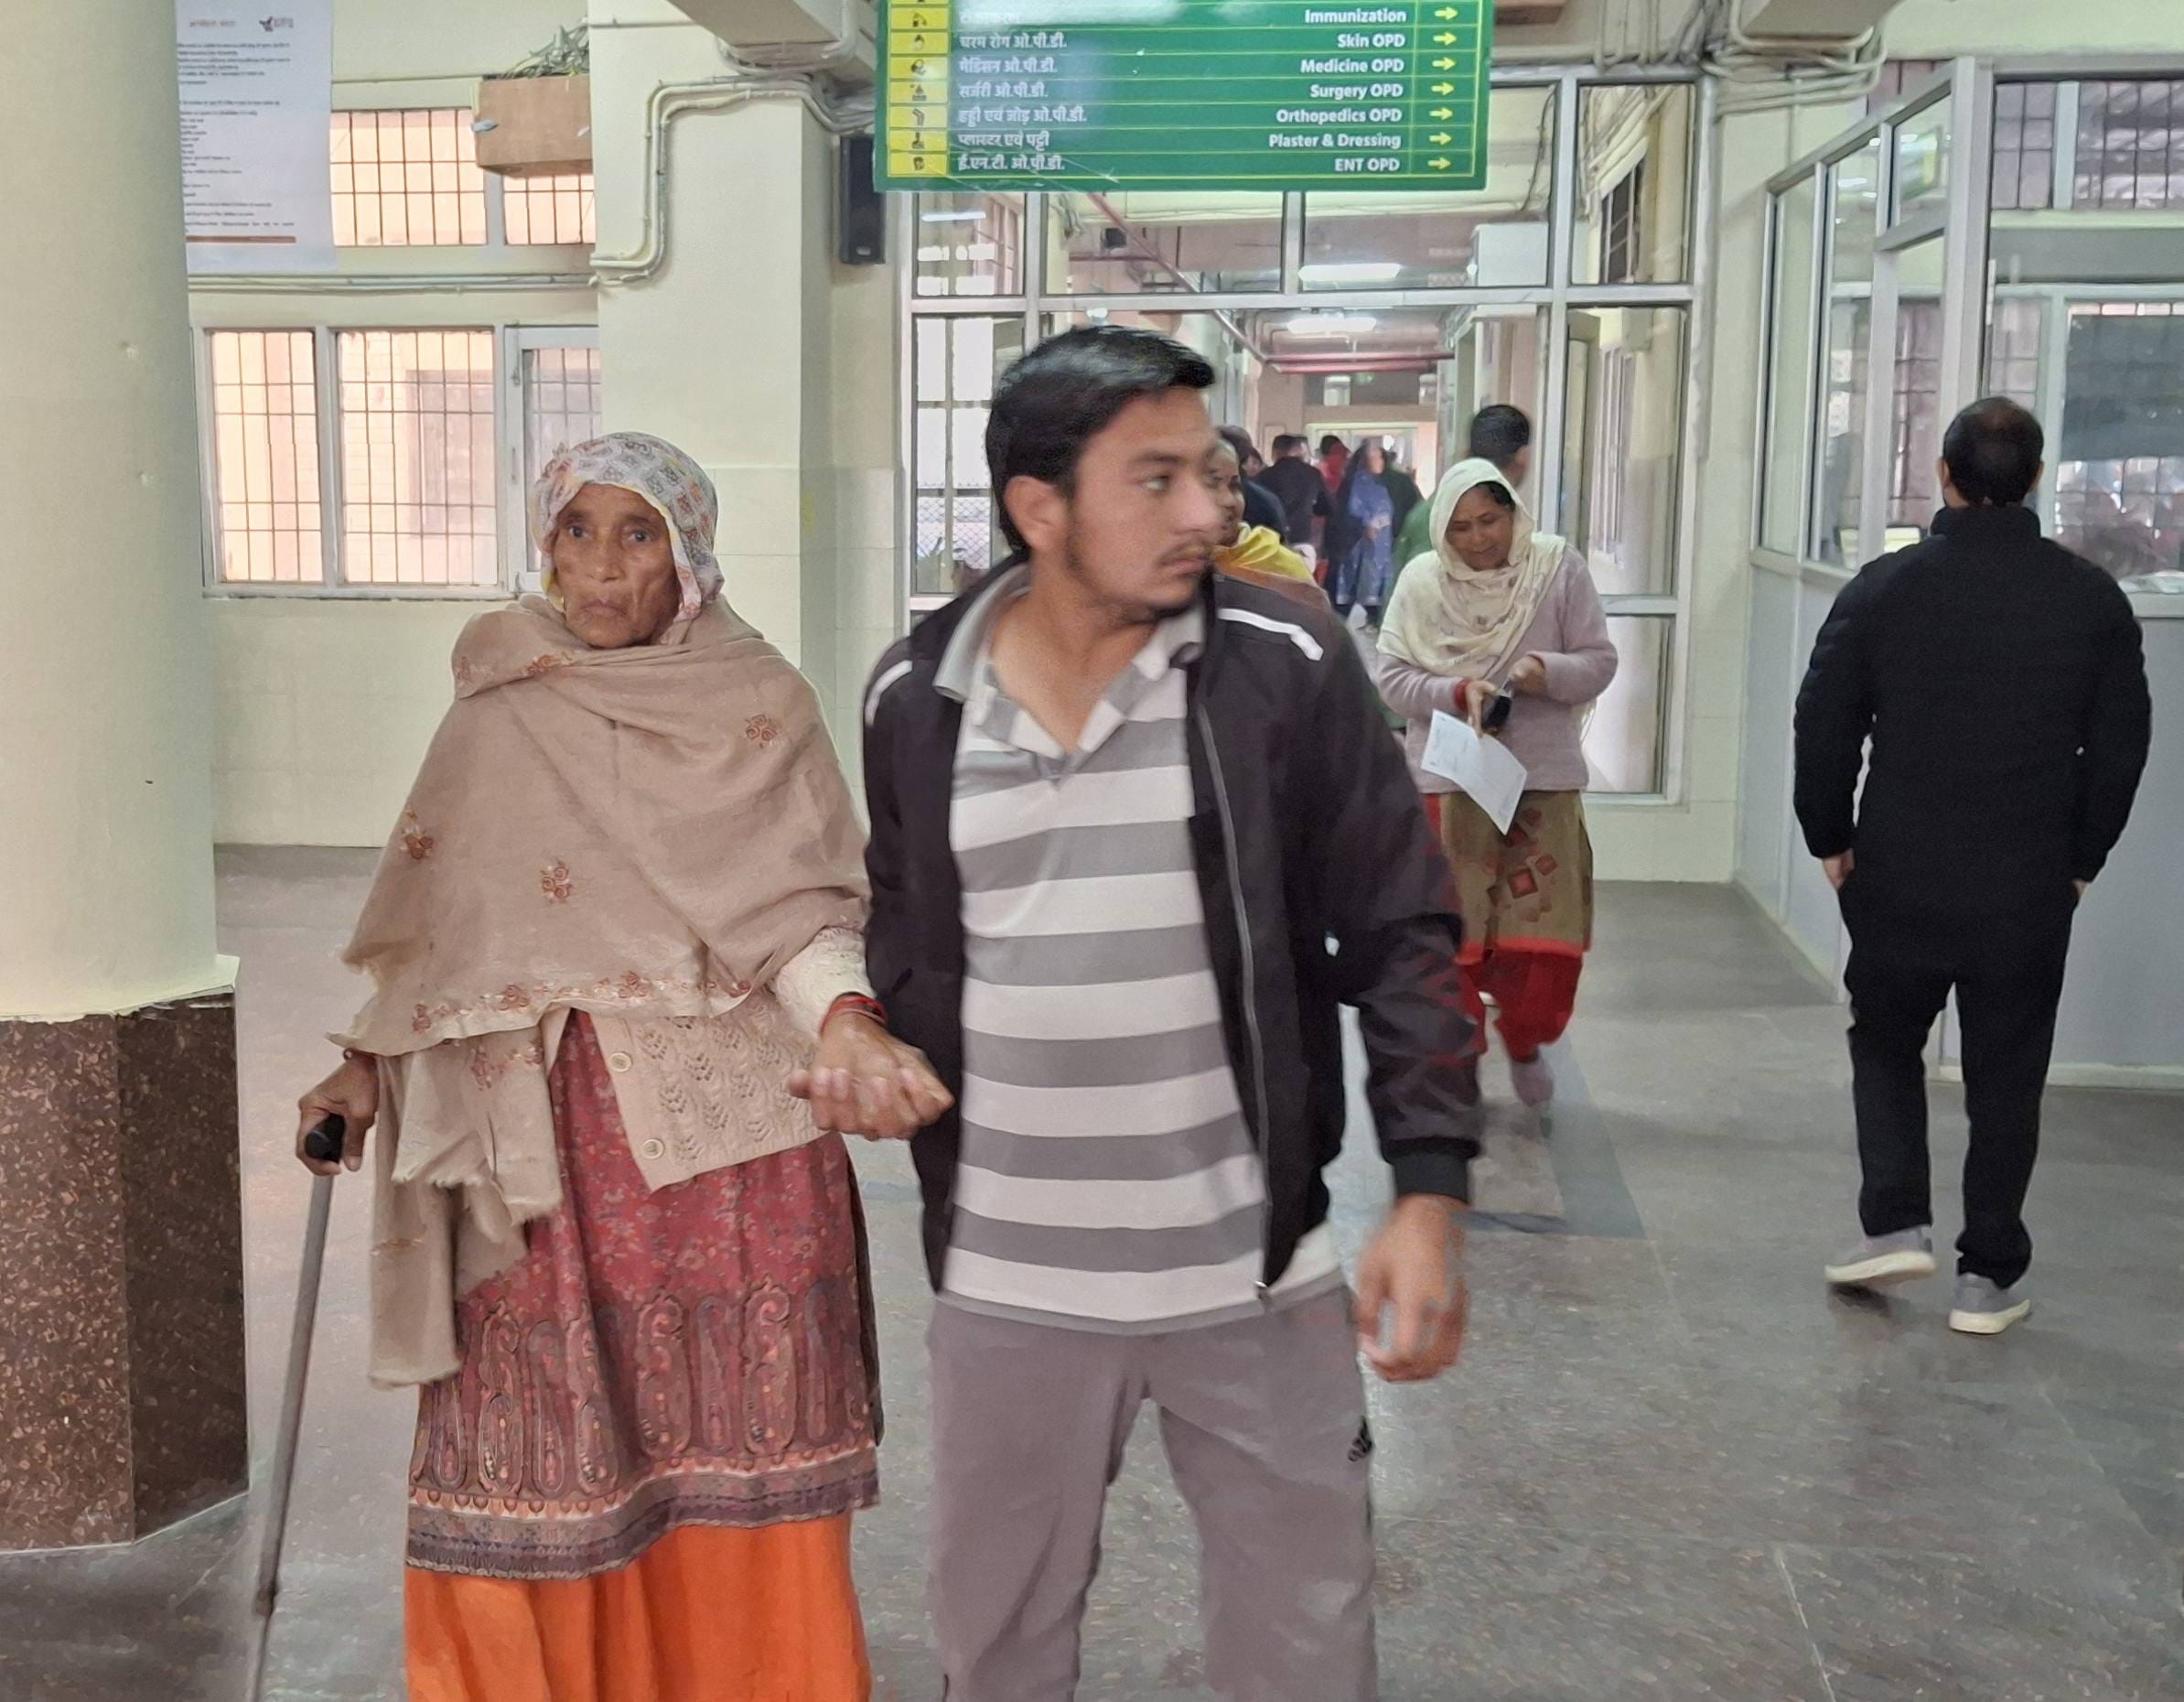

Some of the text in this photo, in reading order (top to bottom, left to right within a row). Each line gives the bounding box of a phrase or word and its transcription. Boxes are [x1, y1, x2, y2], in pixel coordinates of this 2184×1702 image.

[1305, 8, 1406, 24] Immunization
[989, 32, 1011, 48] रोग
[1337, 34, 1405, 48] Skin OPD
[1300, 59, 1404, 73] Medicine OPD
[959, 81, 991, 98] सर्जरी
[1309, 84, 1404, 101] Surgery OPD
[1276, 108, 1403, 125] Orthopedics OPD
[1026, 130, 1049, 151] पट्टी
[1269, 133, 1402, 149] Plaster & Dressing
[1335, 157, 1400, 172] ENT OPD
